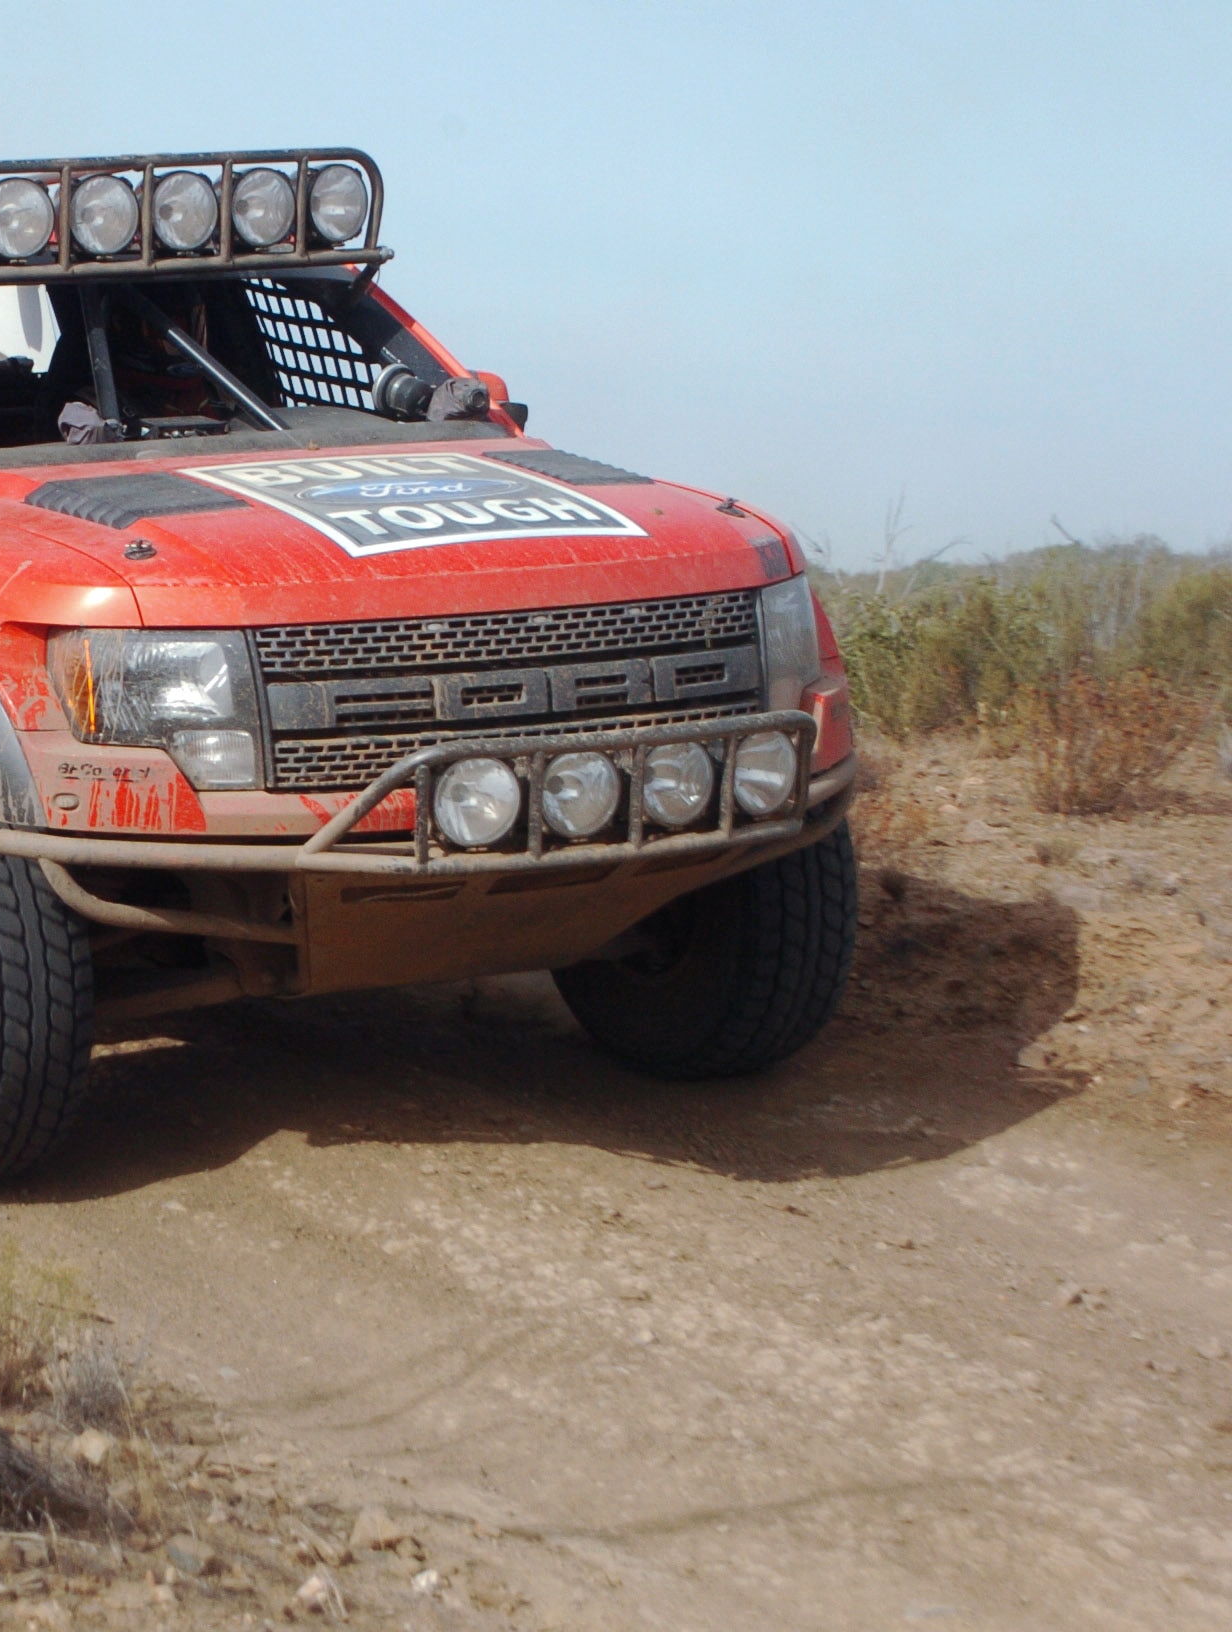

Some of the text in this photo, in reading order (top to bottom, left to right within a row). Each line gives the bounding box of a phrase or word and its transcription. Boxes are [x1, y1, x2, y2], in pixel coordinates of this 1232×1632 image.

[220, 455, 484, 487] BUILT
[360, 480, 474, 499] Ford
[326, 496, 602, 537] TOUGH
[268, 644, 759, 731] FORD
